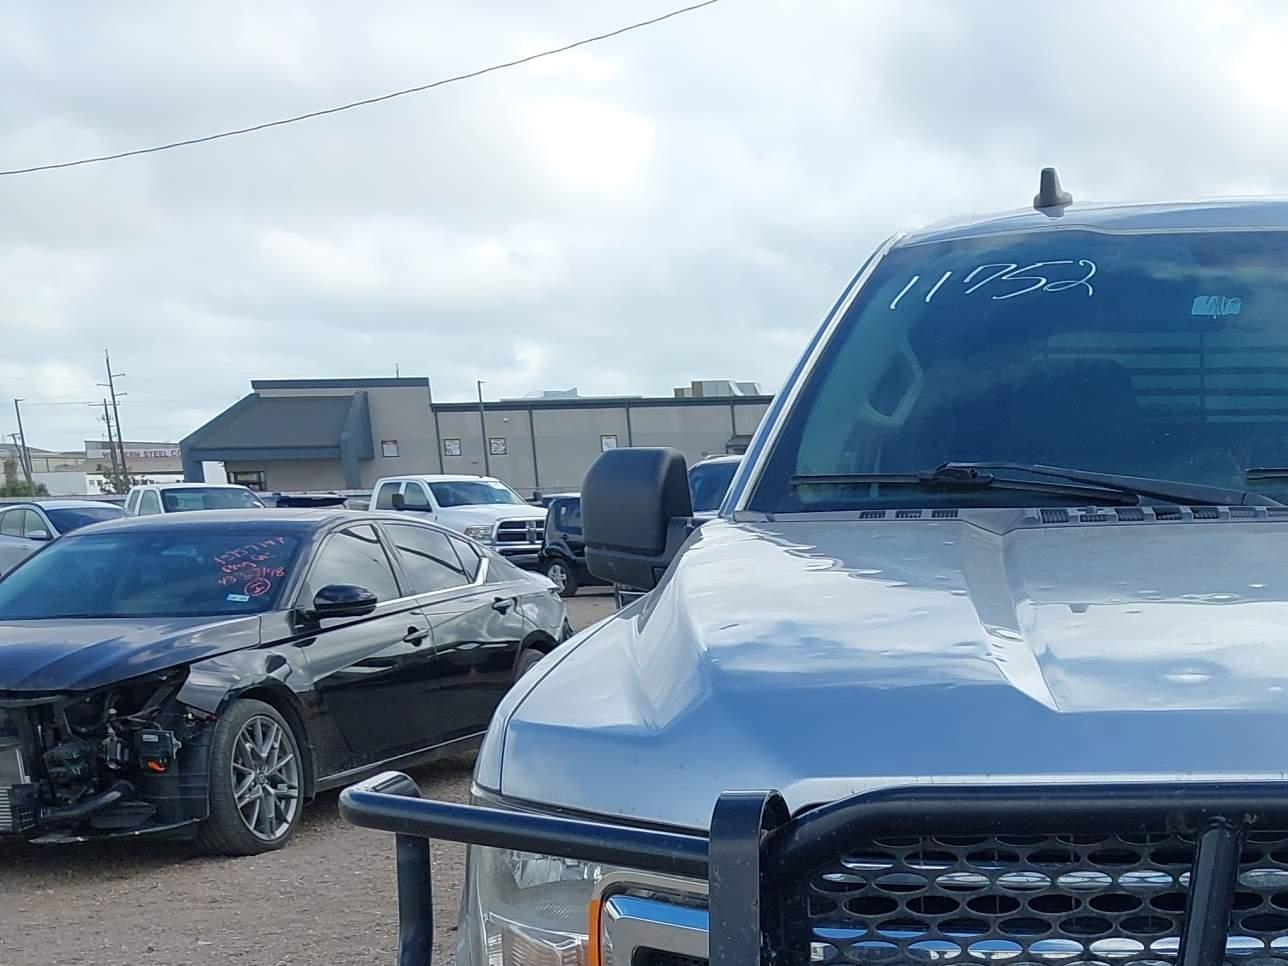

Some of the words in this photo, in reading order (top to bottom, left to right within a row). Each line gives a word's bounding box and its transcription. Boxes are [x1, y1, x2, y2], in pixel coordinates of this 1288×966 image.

[889, 260, 1097, 310] 11752
[102, 451, 140, 459] WERN
[143, 450, 168, 458] STEEL
